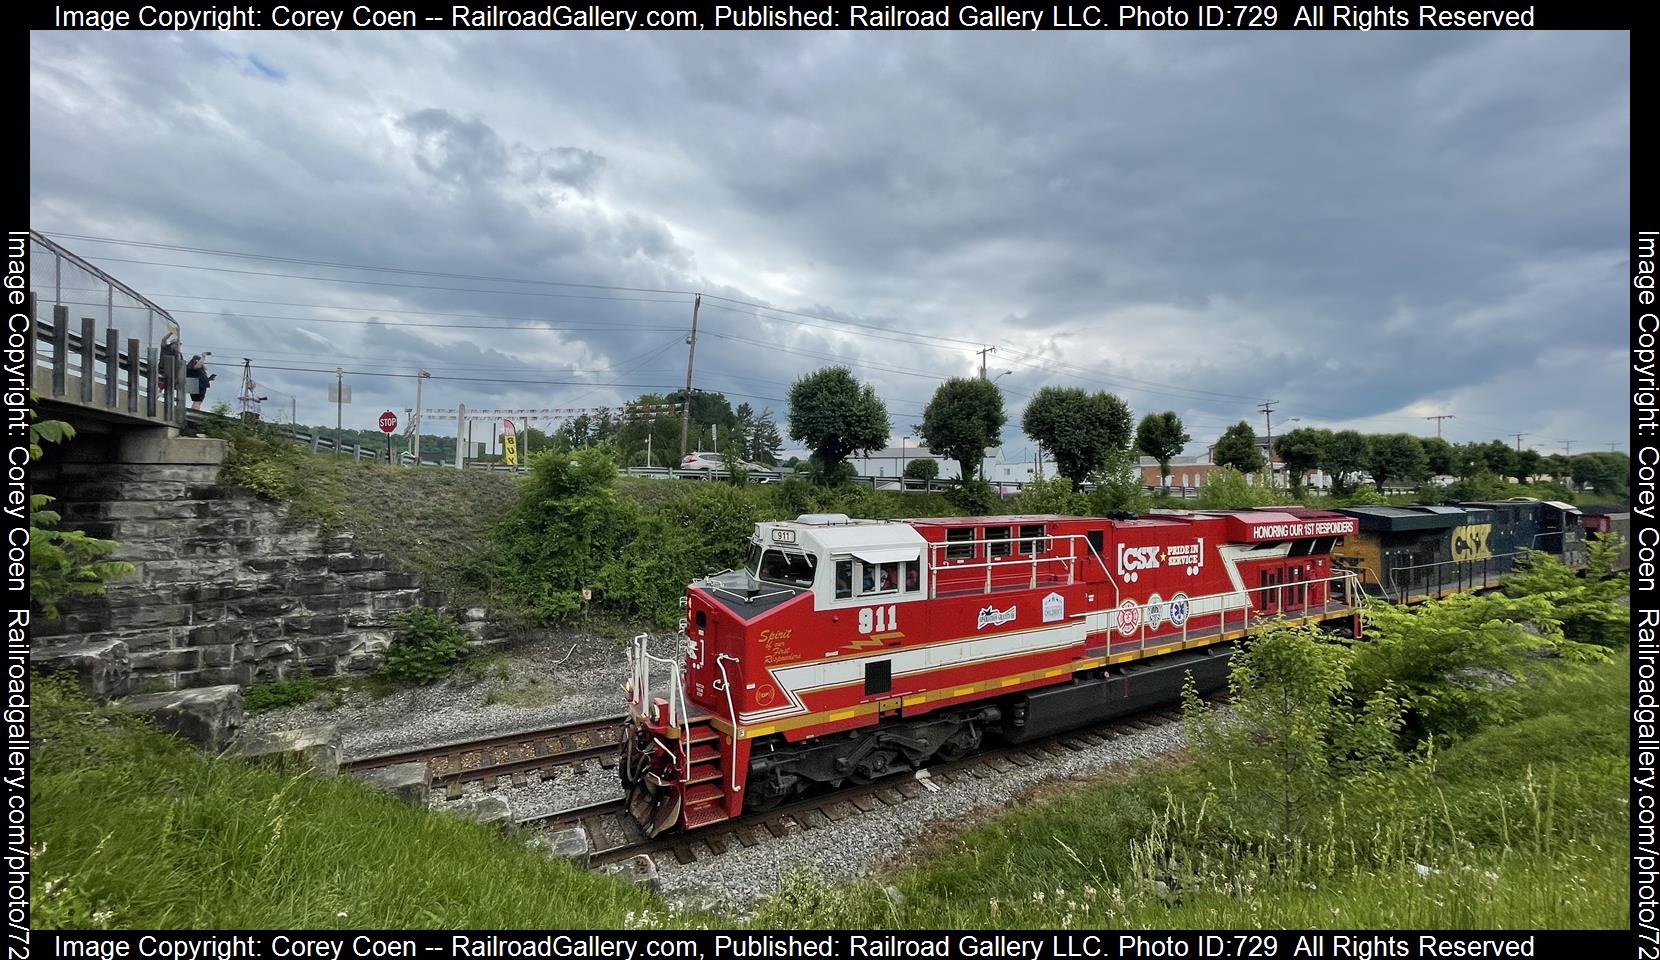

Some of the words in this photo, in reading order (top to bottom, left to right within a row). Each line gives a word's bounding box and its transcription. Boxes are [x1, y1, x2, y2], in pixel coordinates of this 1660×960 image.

[379, 417, 396, 427] STOP
[507, 437, 515, 464] BUY
[777, 530, 790, 541] 911
[1253, 525, 1288, 539] HONORING
[1289, 524, 1303, 537] OUR
[1304, 523, 1315, 535] 1ST
[1315, 521, 1354, 535] RESPONDERS
[1167, 545, 1189, 556] PRIDE
[1190, 544, 1199, 554] IN
[1451, 523, 1493, 562] CSX
[1123, 546, 1160, 571] CSX
[1168, 554, 1198, 566] SERVICE
[858, 605, 897, 634] 911
[758, 629, 792, 643] Spirit
